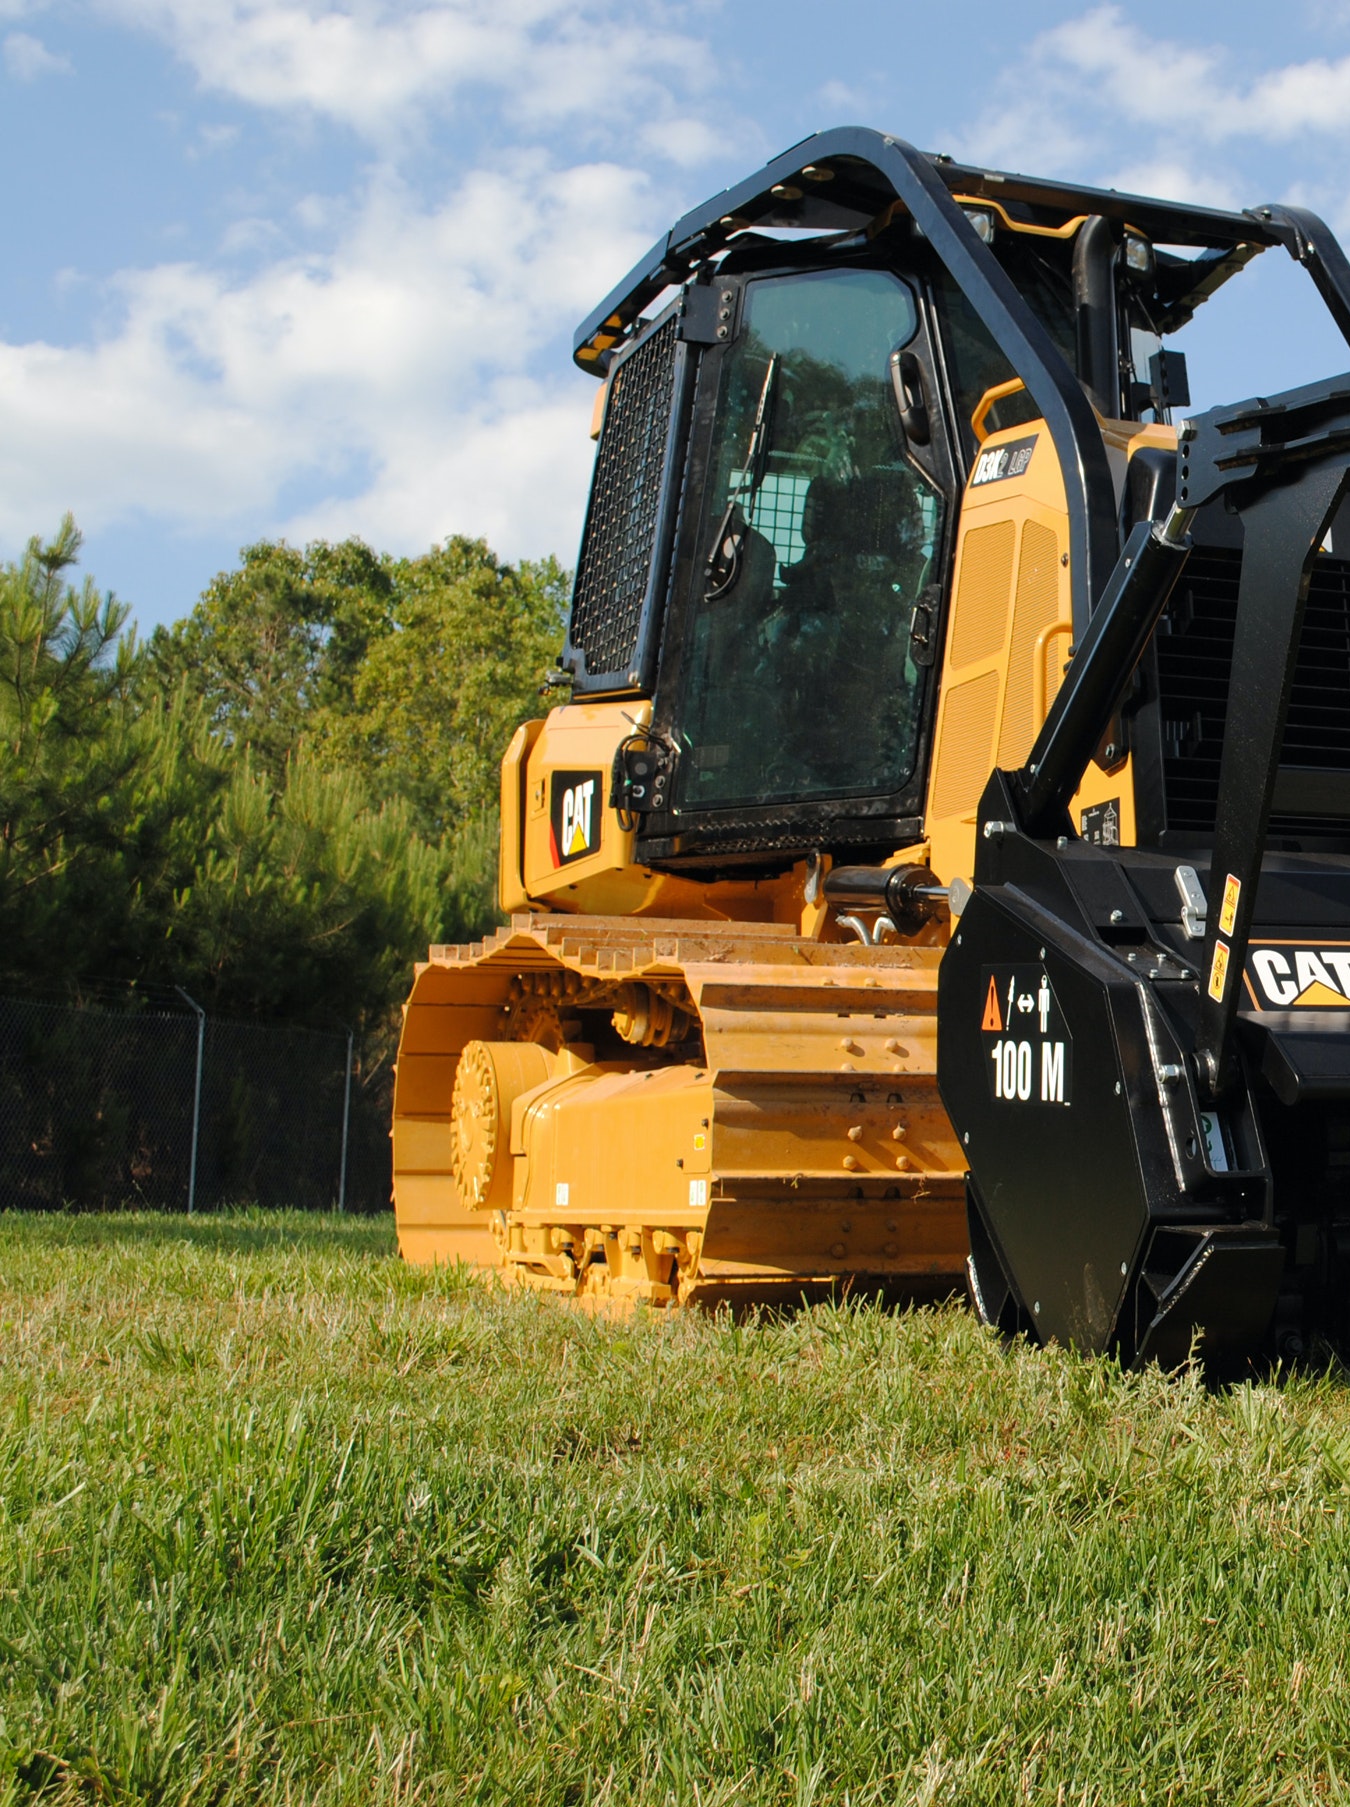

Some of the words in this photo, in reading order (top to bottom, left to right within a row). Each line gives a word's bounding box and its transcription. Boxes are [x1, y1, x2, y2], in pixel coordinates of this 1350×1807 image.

[973, 448, 1008, 485] D3K2
[1008, 447, 1033, 476] LGP
[562, 779, 595, 857] CAT
[991, 1040, 1032, 1101] 100
[1041, 1042, 1065, 1102] M
